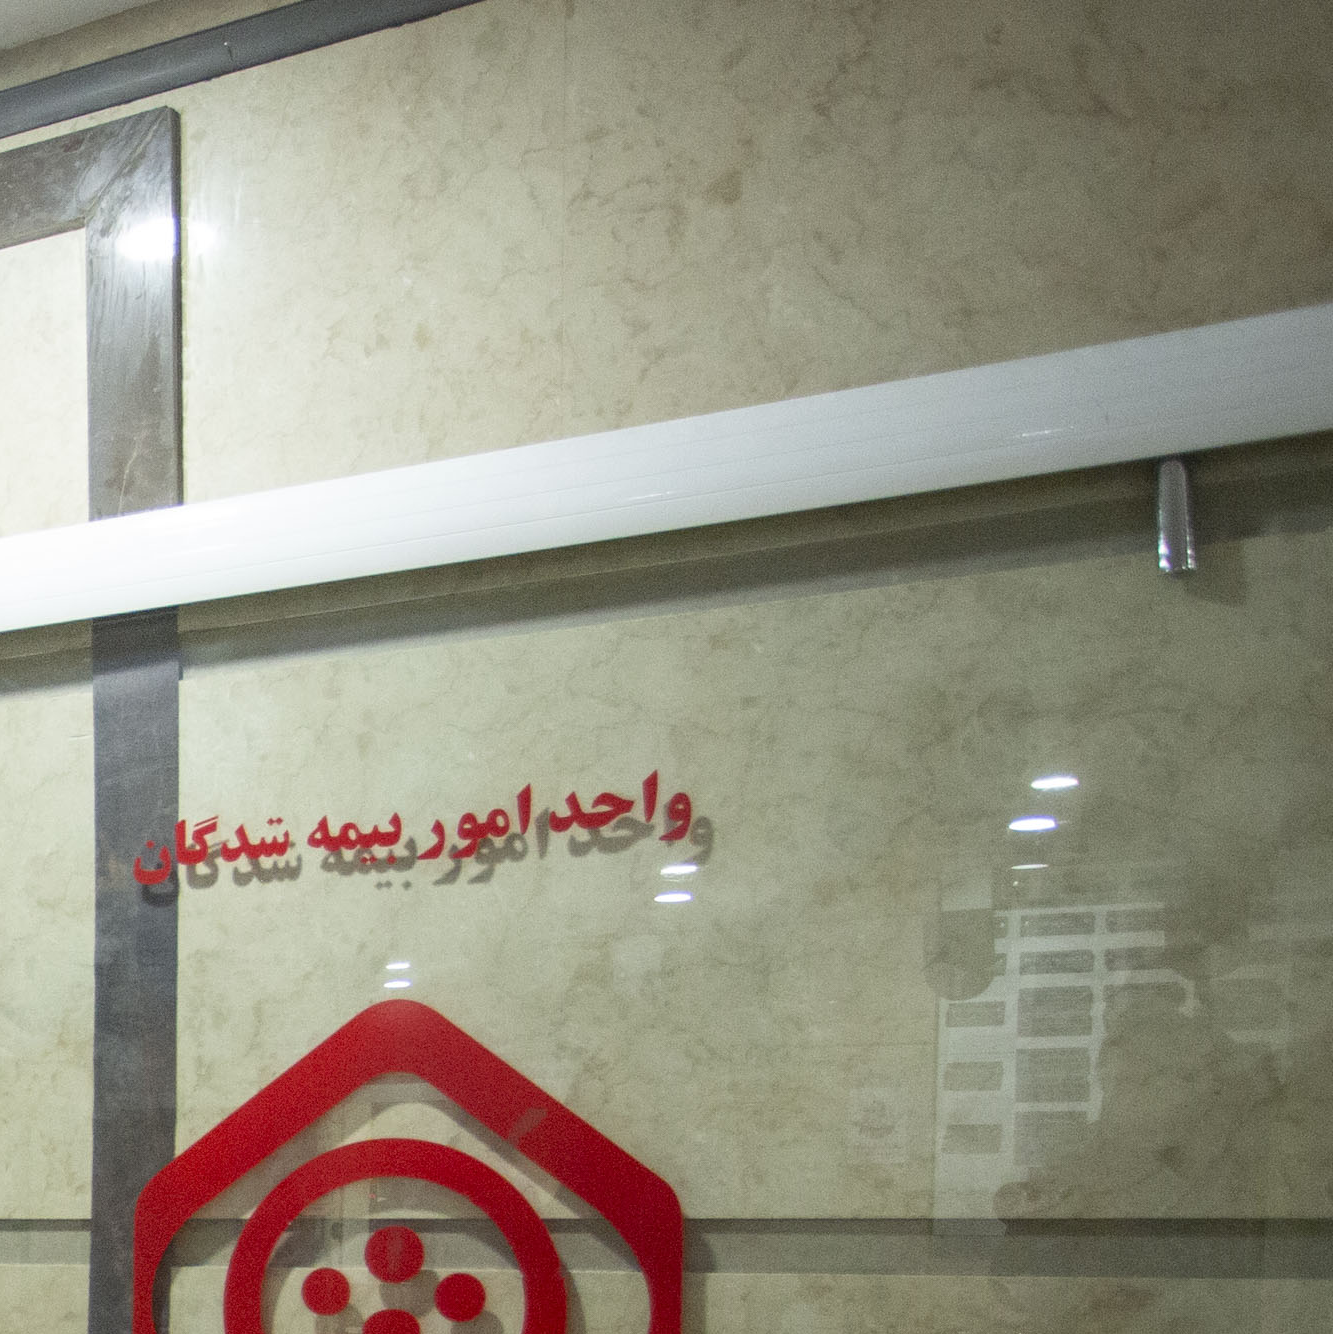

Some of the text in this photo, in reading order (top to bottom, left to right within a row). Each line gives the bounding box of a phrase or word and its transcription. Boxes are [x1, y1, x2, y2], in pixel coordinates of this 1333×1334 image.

[307, 812, 402, 866] بیمه
[417, 784, 532, 860] امور
[549, 770, 694, 842] واحد
